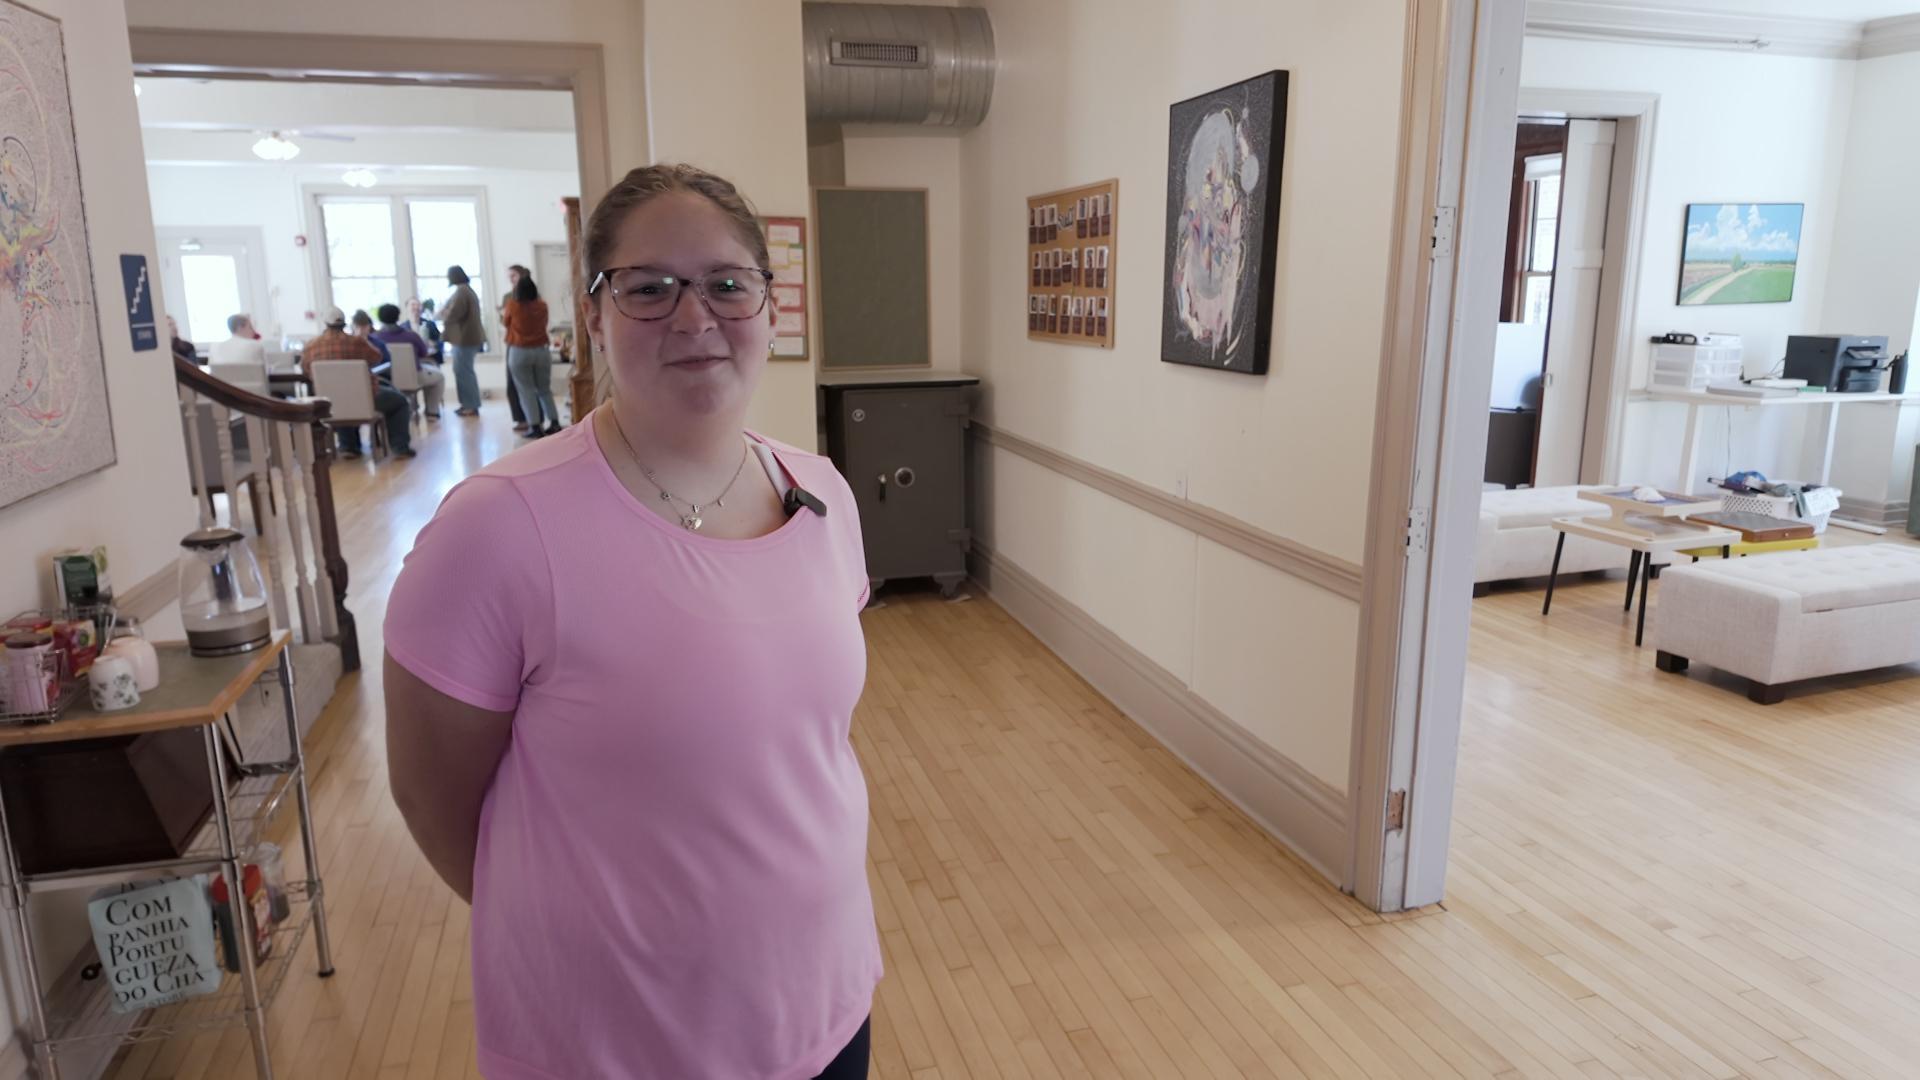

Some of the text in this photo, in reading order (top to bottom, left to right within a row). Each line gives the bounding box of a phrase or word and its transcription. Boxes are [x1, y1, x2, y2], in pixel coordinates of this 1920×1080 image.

[106, 896, 171, 926] COM
[109, 917, 189, 947] PANHIA
[110, 936, 184, 967] PORTU
[115, 953, 199, 985] GUEZA
